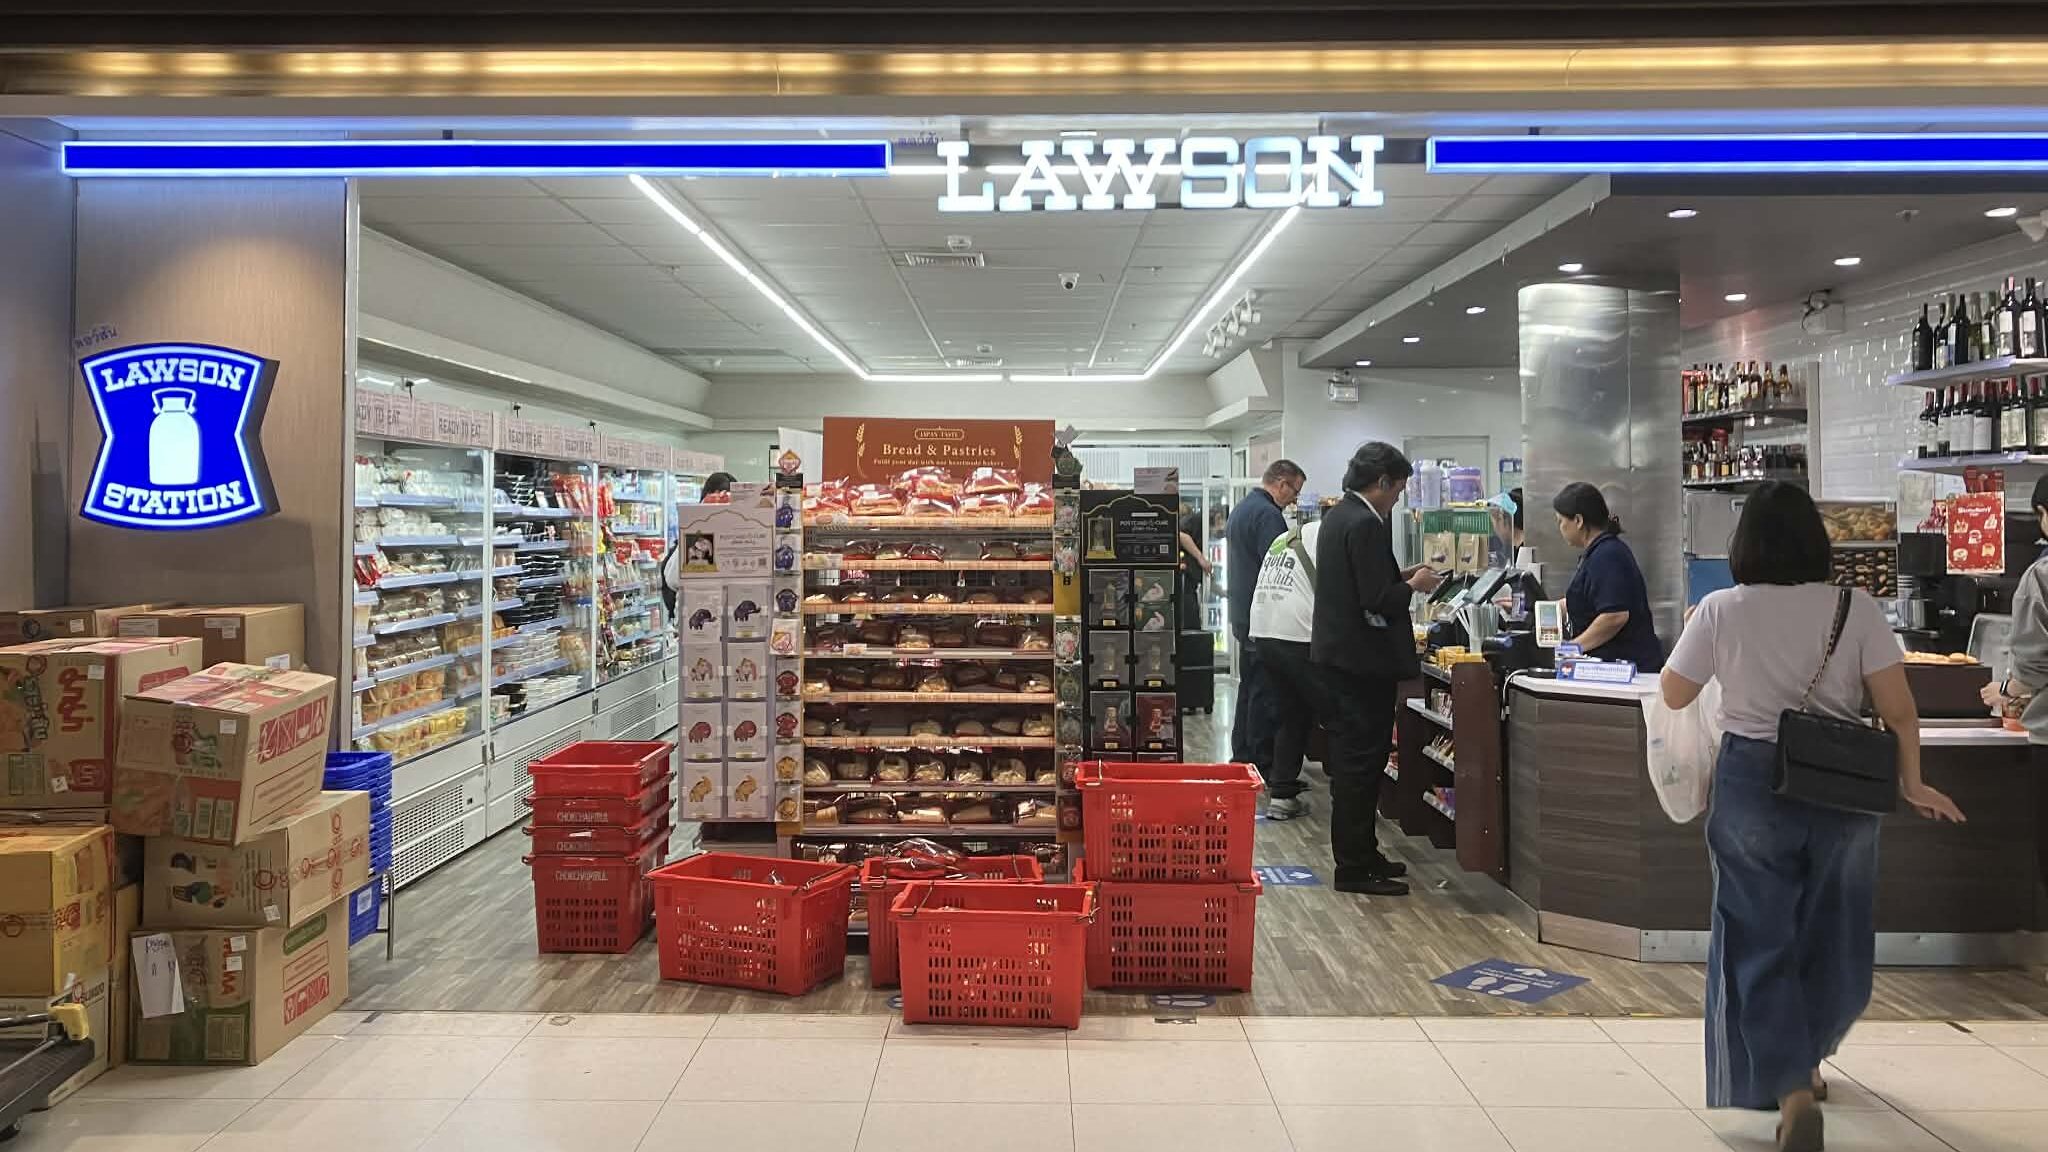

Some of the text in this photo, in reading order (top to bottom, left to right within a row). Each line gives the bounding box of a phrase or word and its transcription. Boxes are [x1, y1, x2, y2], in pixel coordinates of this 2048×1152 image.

[937, 134, 1385, 212] LAWSON
[101, 357, 246, 393] LAWSON
[375, 405, 385, 423] TO
[387, 408, 401, 426] EAT
[438, 417, 481, 437] READY TO EAT
[883, 443, 997, 457] Bread & Pastries
[103, 480, 244, 515] STATION
